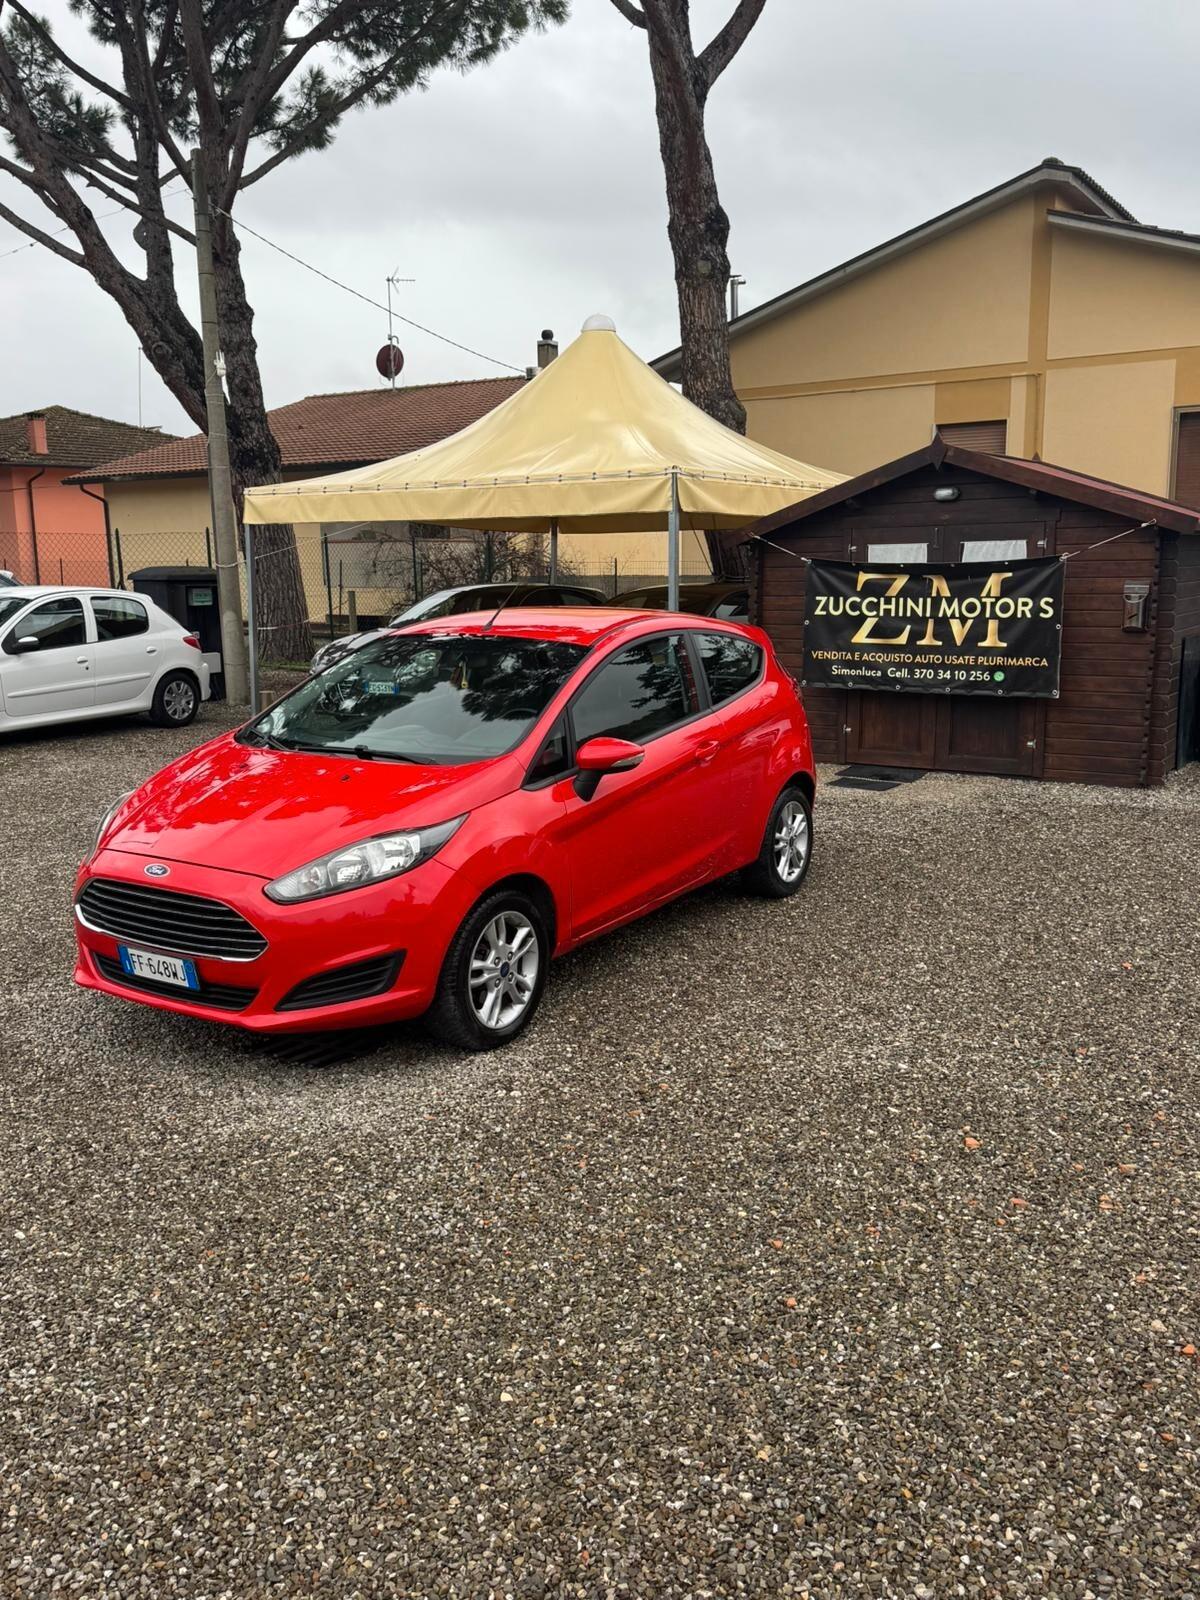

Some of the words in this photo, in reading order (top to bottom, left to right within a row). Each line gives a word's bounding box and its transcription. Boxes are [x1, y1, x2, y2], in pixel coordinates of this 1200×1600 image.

[814, 596, 932, 617] ZUCCHINI
[811, 650, 853, 660] VENDITA
[854, 651, 860, 660] E
[861, 652, 913, 663] ACQUISTO
[914, 654, 943, 664] AUTO
[944, 655, 976, 665] USATE
[977, 656, 1049, 667] PLURIMARCA
[831, 665, 882, 677] Simonluca
[887, 667, 911, 678] Cell.
[913, 668, 934, 679] 370
[936, 670, 951, 680] 34
[954, 670, 967, 680] 10
[969, 670, 991, 681] 256
